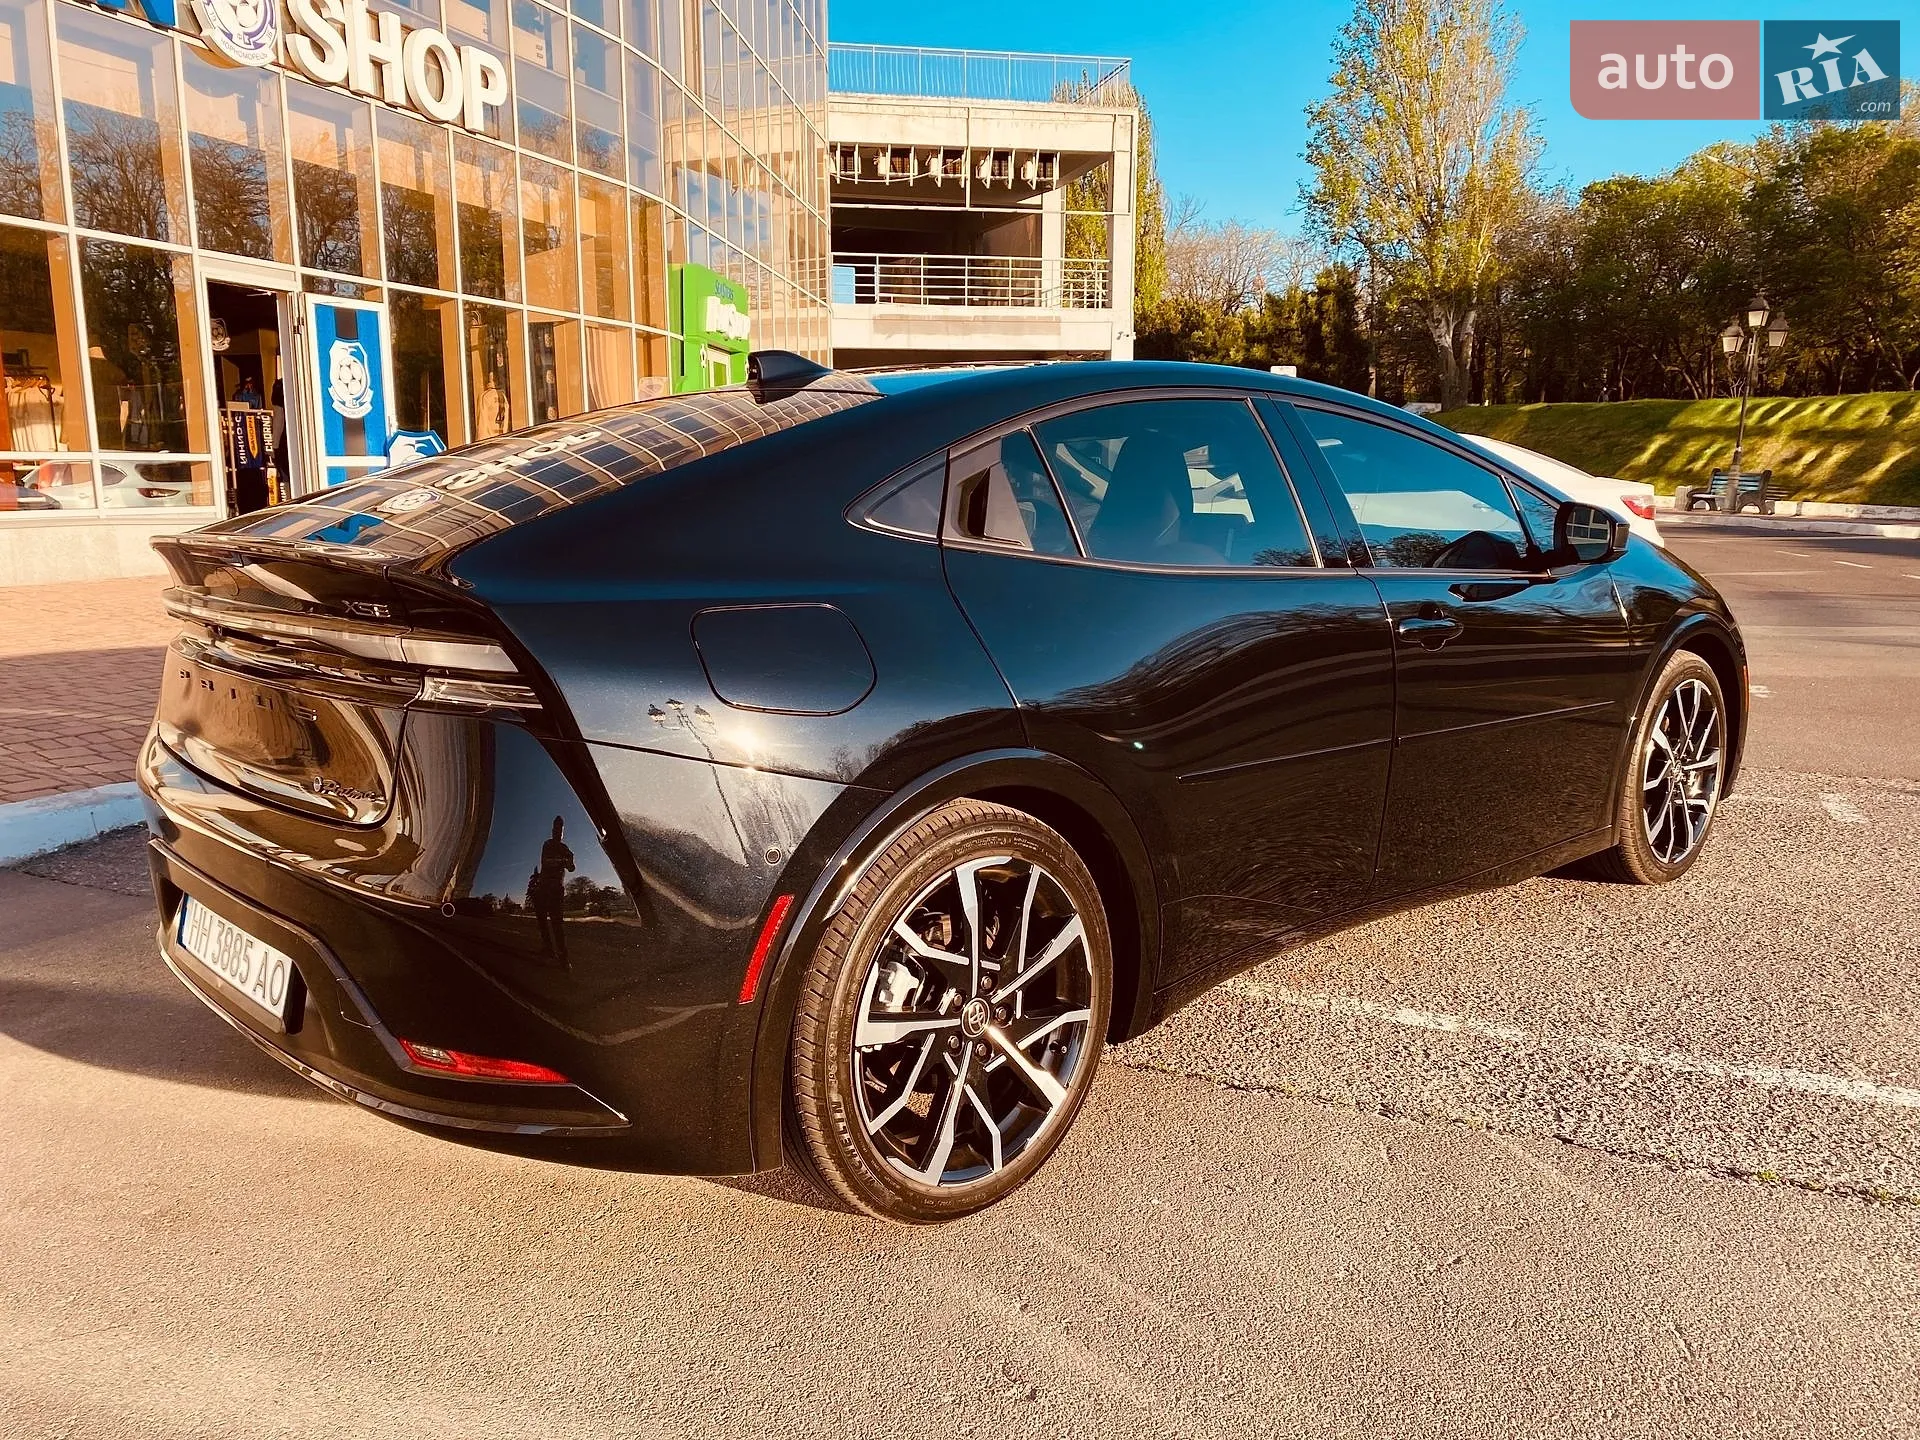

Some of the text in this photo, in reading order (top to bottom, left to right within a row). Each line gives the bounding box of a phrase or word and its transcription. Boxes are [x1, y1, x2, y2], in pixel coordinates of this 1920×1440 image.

[287, 0, 508, 132] SHOP
[341, 599, 391, 618] XSE
[188, 902, 286, 1006] HH 3885 AO
